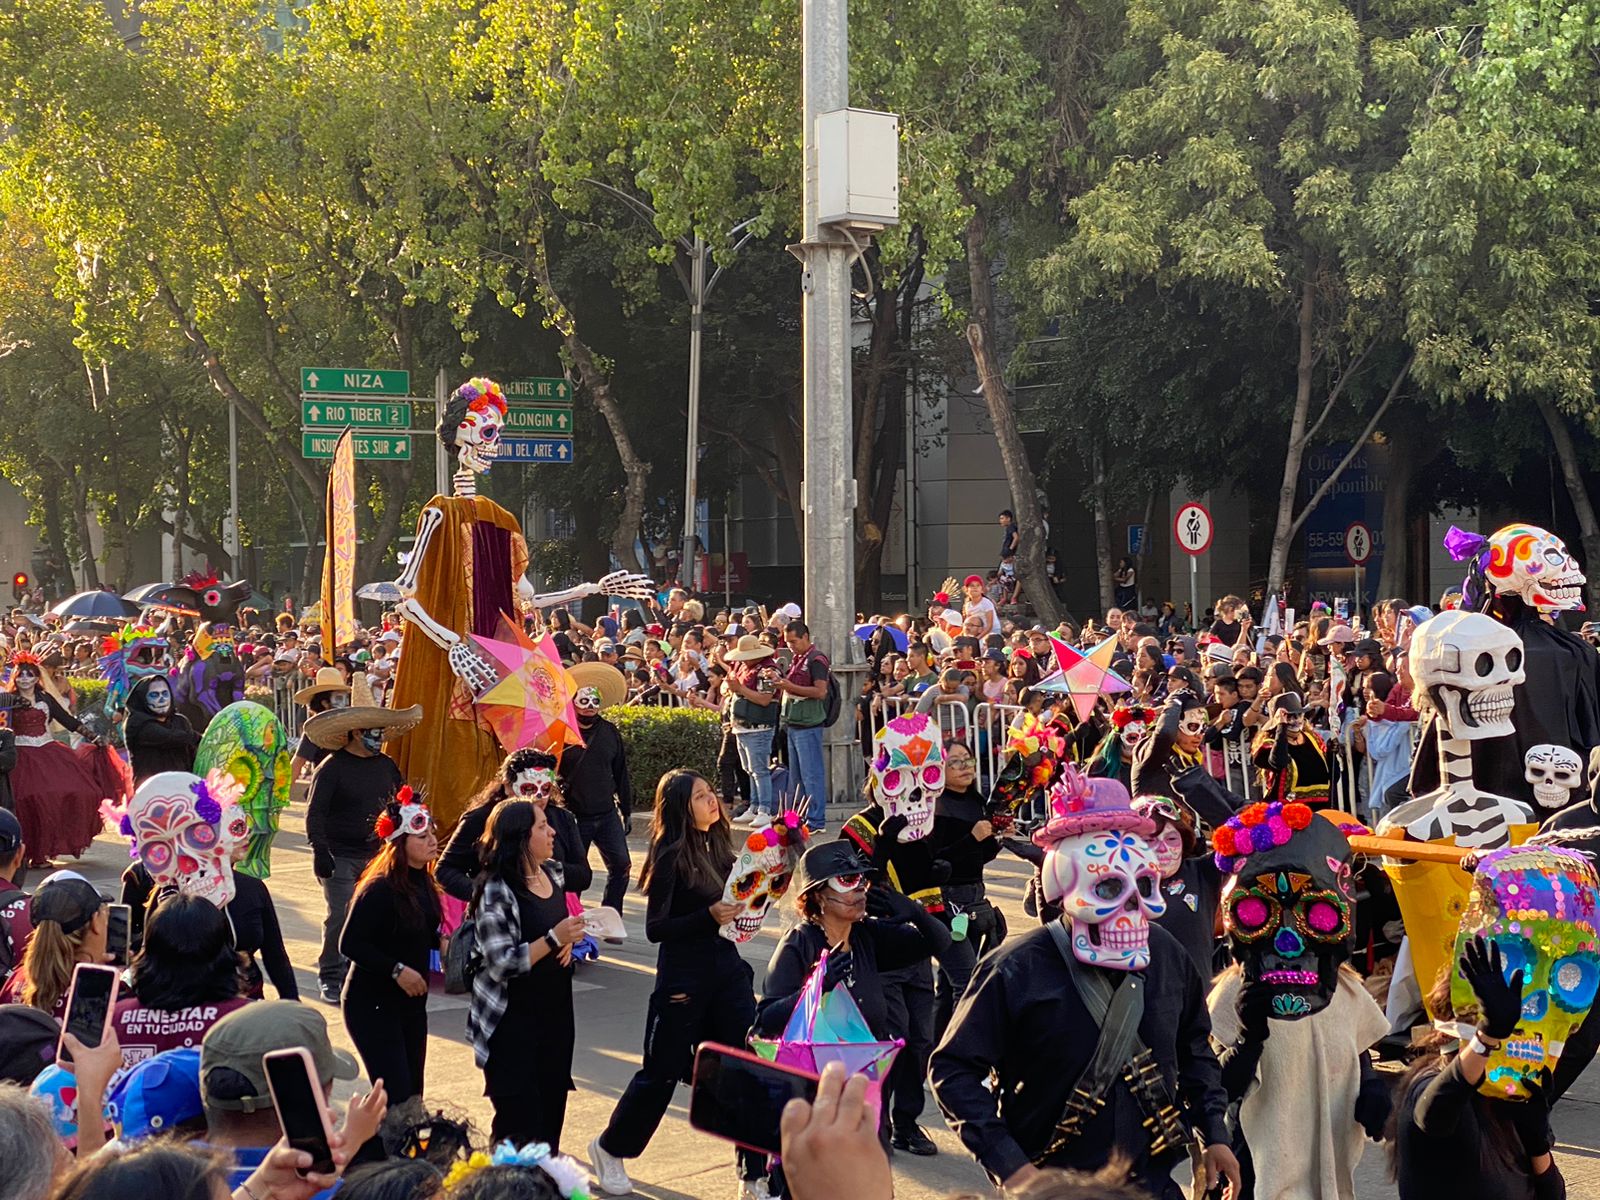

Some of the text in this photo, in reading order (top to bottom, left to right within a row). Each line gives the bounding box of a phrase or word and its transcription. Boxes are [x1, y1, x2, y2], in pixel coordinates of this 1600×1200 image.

[344, 374, 384, 388] NIZA
[538, 382, 552, 396] NTE
[326, 406, 345, 420] RIO
[349, 407, 382, 421] TIBER
[372, 440, 390, 454] SUR
[515, 443, 531, 457] DEL
[534, 443, 553, 457] ARTE
[121, 1006, 218, 1024] BIENESTAR
[126, 1021, 204, 1035] EN TU CIUDAD
